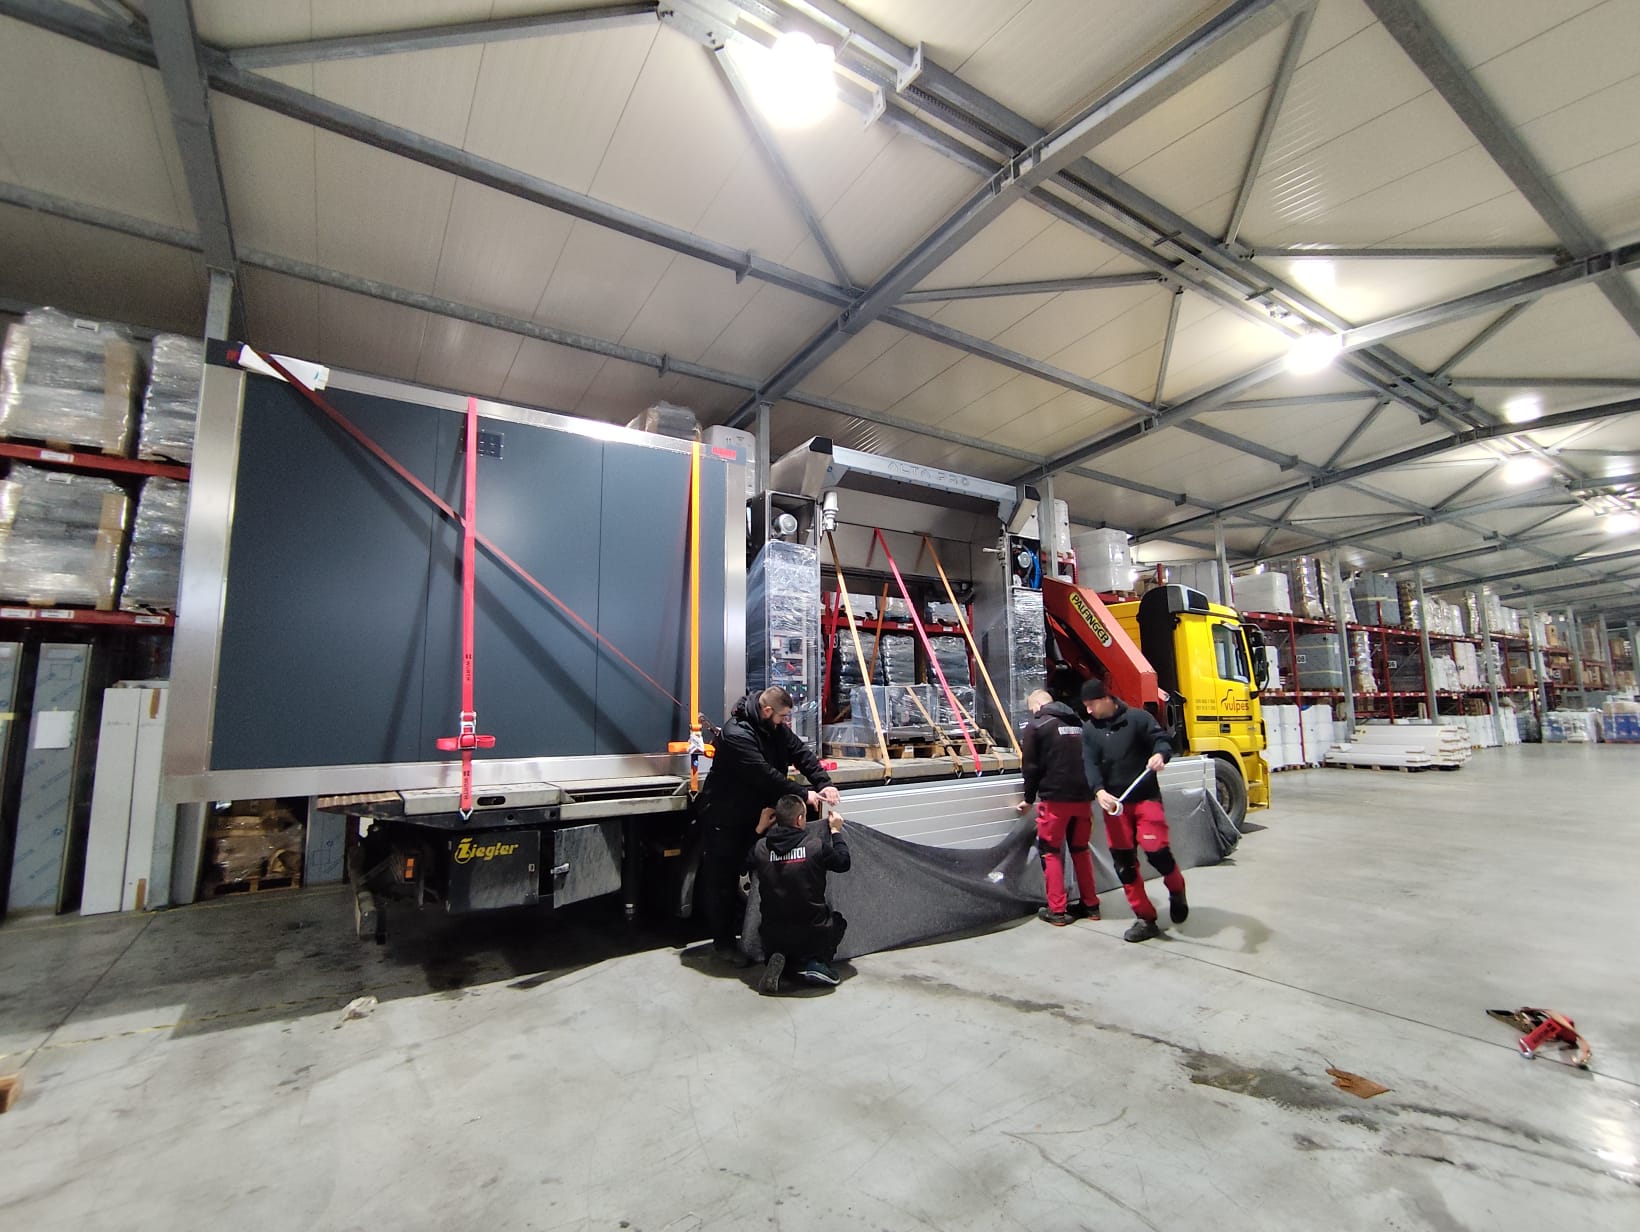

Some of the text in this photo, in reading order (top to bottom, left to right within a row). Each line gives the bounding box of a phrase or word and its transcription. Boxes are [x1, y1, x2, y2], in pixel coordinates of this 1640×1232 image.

[1071, 594, 1110, 644] PALFINGER
[1224, 697, 1250, 712] vulpes
[455, 838, 519, 864] Ziegler
